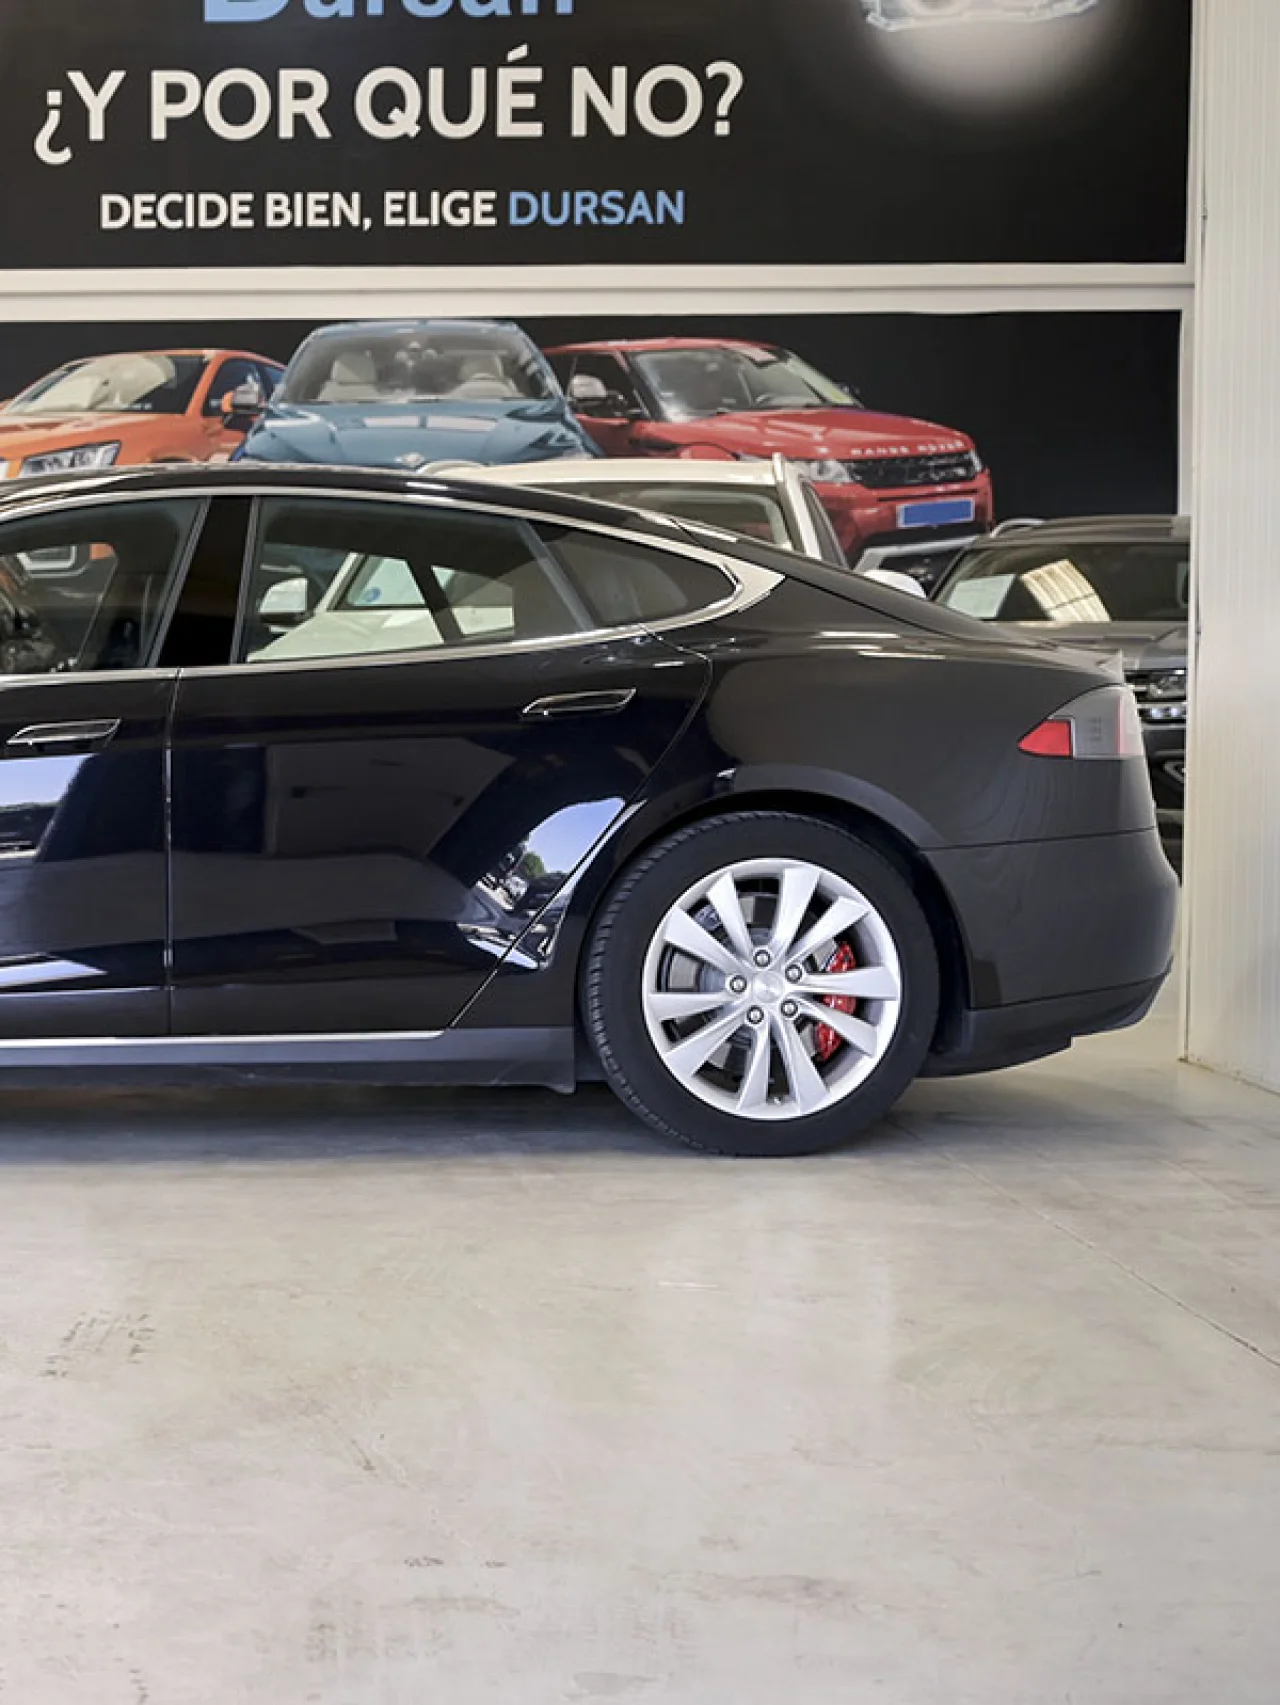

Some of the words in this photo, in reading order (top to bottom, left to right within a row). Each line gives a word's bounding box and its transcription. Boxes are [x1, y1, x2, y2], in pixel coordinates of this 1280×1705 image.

[33, 69, 126, 165] ¿Y
[150, 67, 332, 141] POR
[354, 44, 543, 140] QUÉ
[571, 61, 744, 138] NO?
[100, 192, 255, 230] DECIDE
[265, 191, 372, 232] BIEN,
[383, 189, 498, 228] ELIGE
[509, 189, 685, 226] DURSAN
